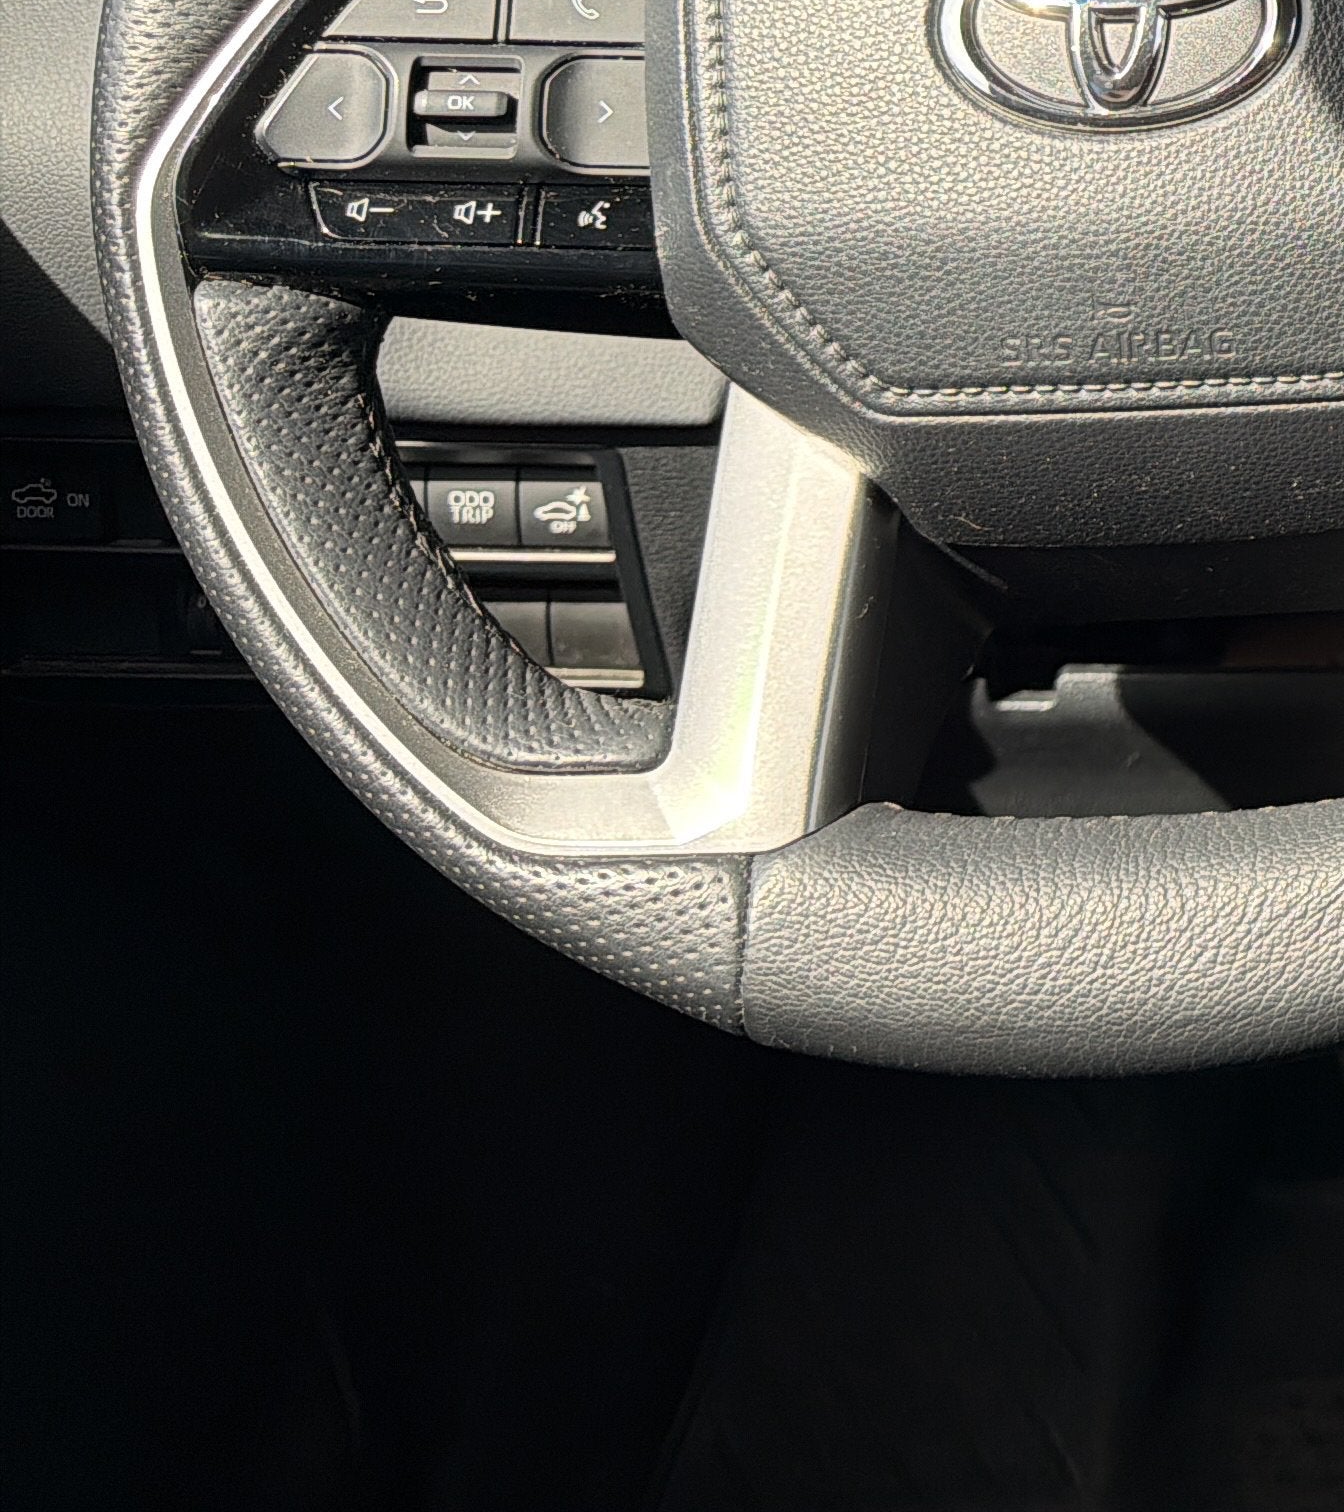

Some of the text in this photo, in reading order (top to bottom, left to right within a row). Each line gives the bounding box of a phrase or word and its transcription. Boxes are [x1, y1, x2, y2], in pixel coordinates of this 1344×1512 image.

[446, 95, 475, 111] OK
[1000, 330, 1237, 367] SRS AIRBAG
[66, 493, 90, 508] ON
[447, 490, 495, 509] ODO
[16, 505, 55, 519] DOOR
[448, 506, 495, 525] TRIP
